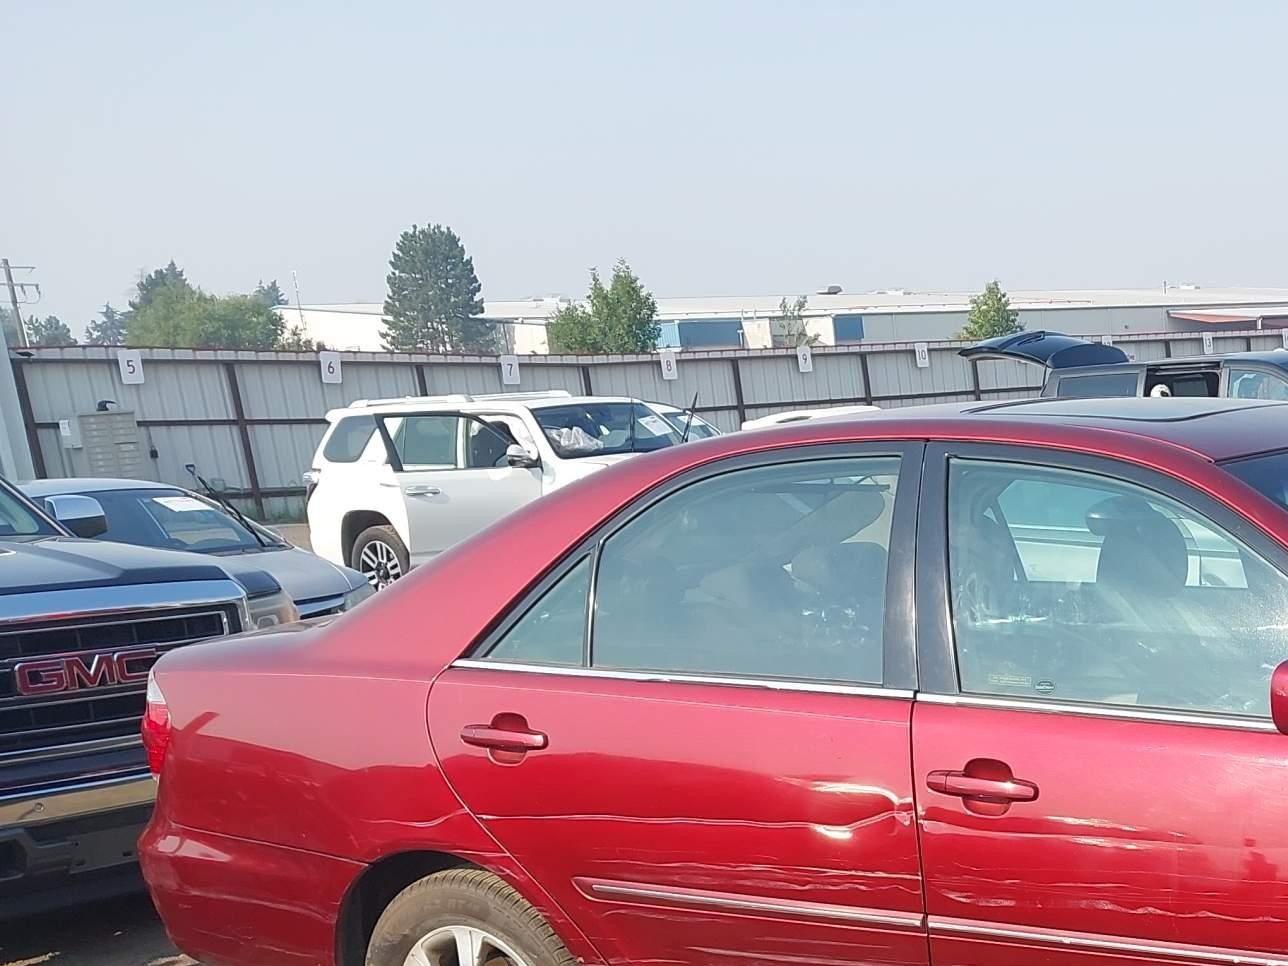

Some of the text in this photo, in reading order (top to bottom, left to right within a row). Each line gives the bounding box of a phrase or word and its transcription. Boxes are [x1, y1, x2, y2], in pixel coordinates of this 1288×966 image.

[802, 353, 808, 364] 9
[917, 349, 926, 360] 10
[126, 359, 136, 374] 5
[327, 361, 335, 374] 6
[506, 363, 513, 376] 7
[666, 359, 672, 372] 8
[14, 648, 157, 696] GMC
